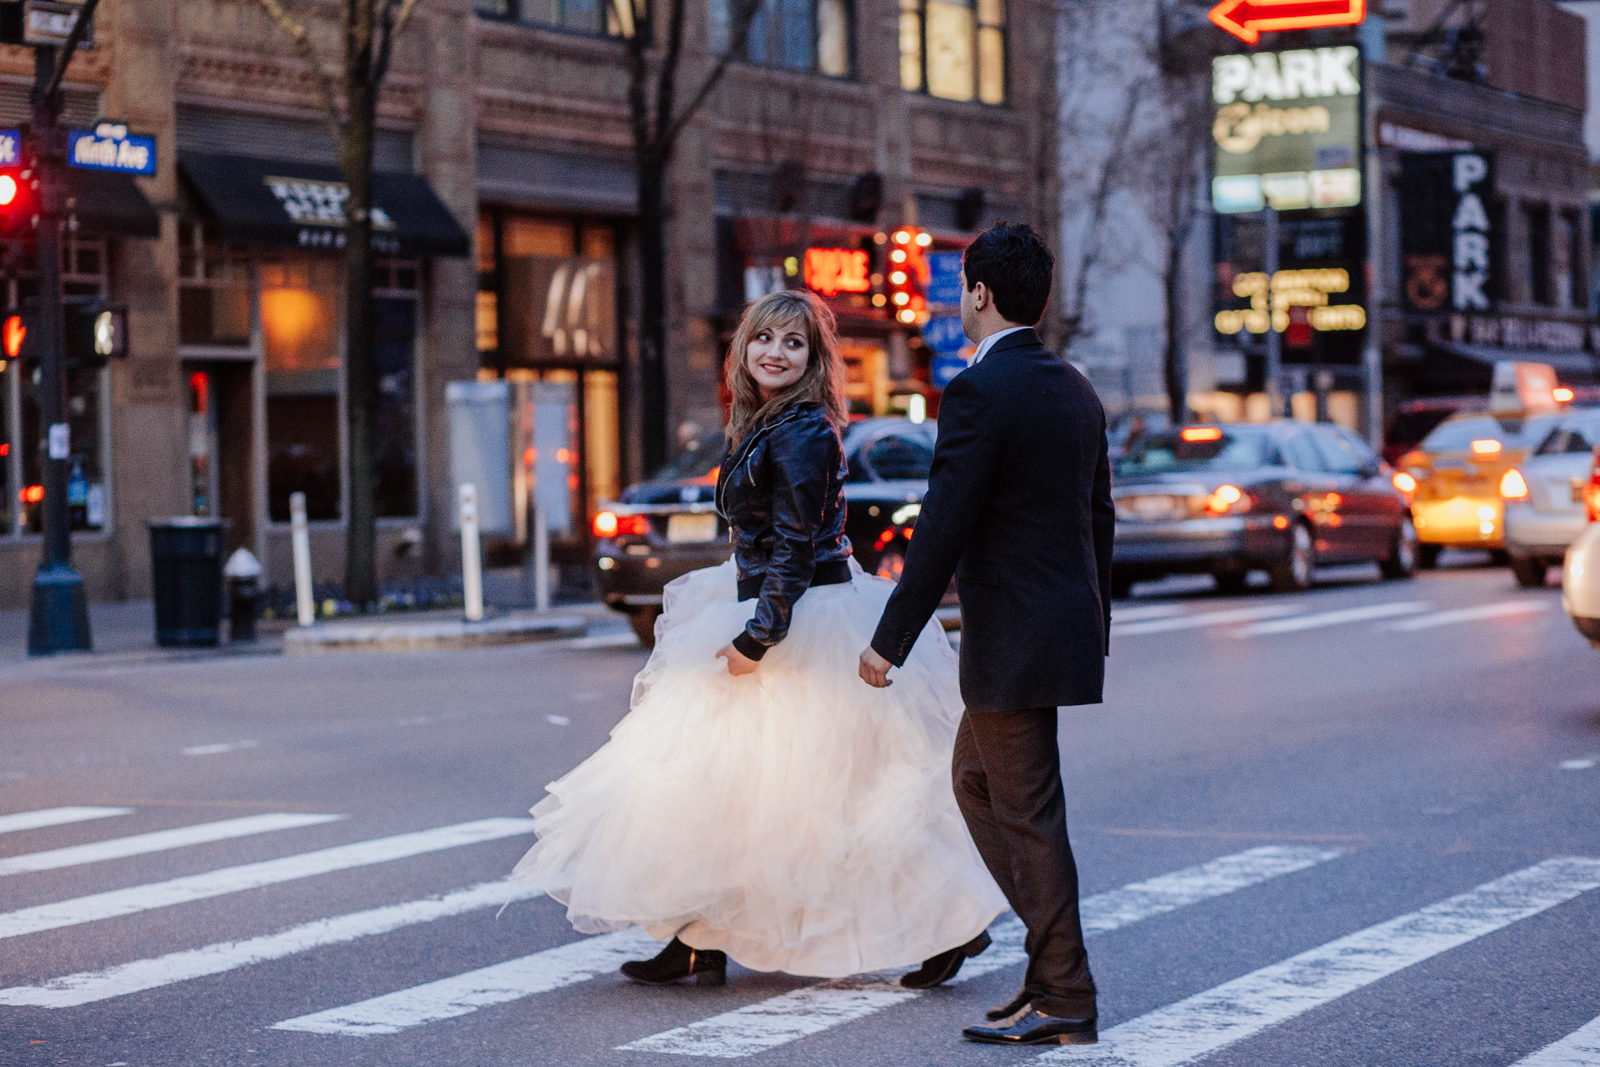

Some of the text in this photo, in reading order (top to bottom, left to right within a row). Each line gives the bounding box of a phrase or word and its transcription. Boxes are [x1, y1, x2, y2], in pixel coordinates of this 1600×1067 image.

[1213, 46, 1360, 103] PARK
[75, 136, 148, 170] Ninth Ave
[1452, 154, 1490, 310] PARK
